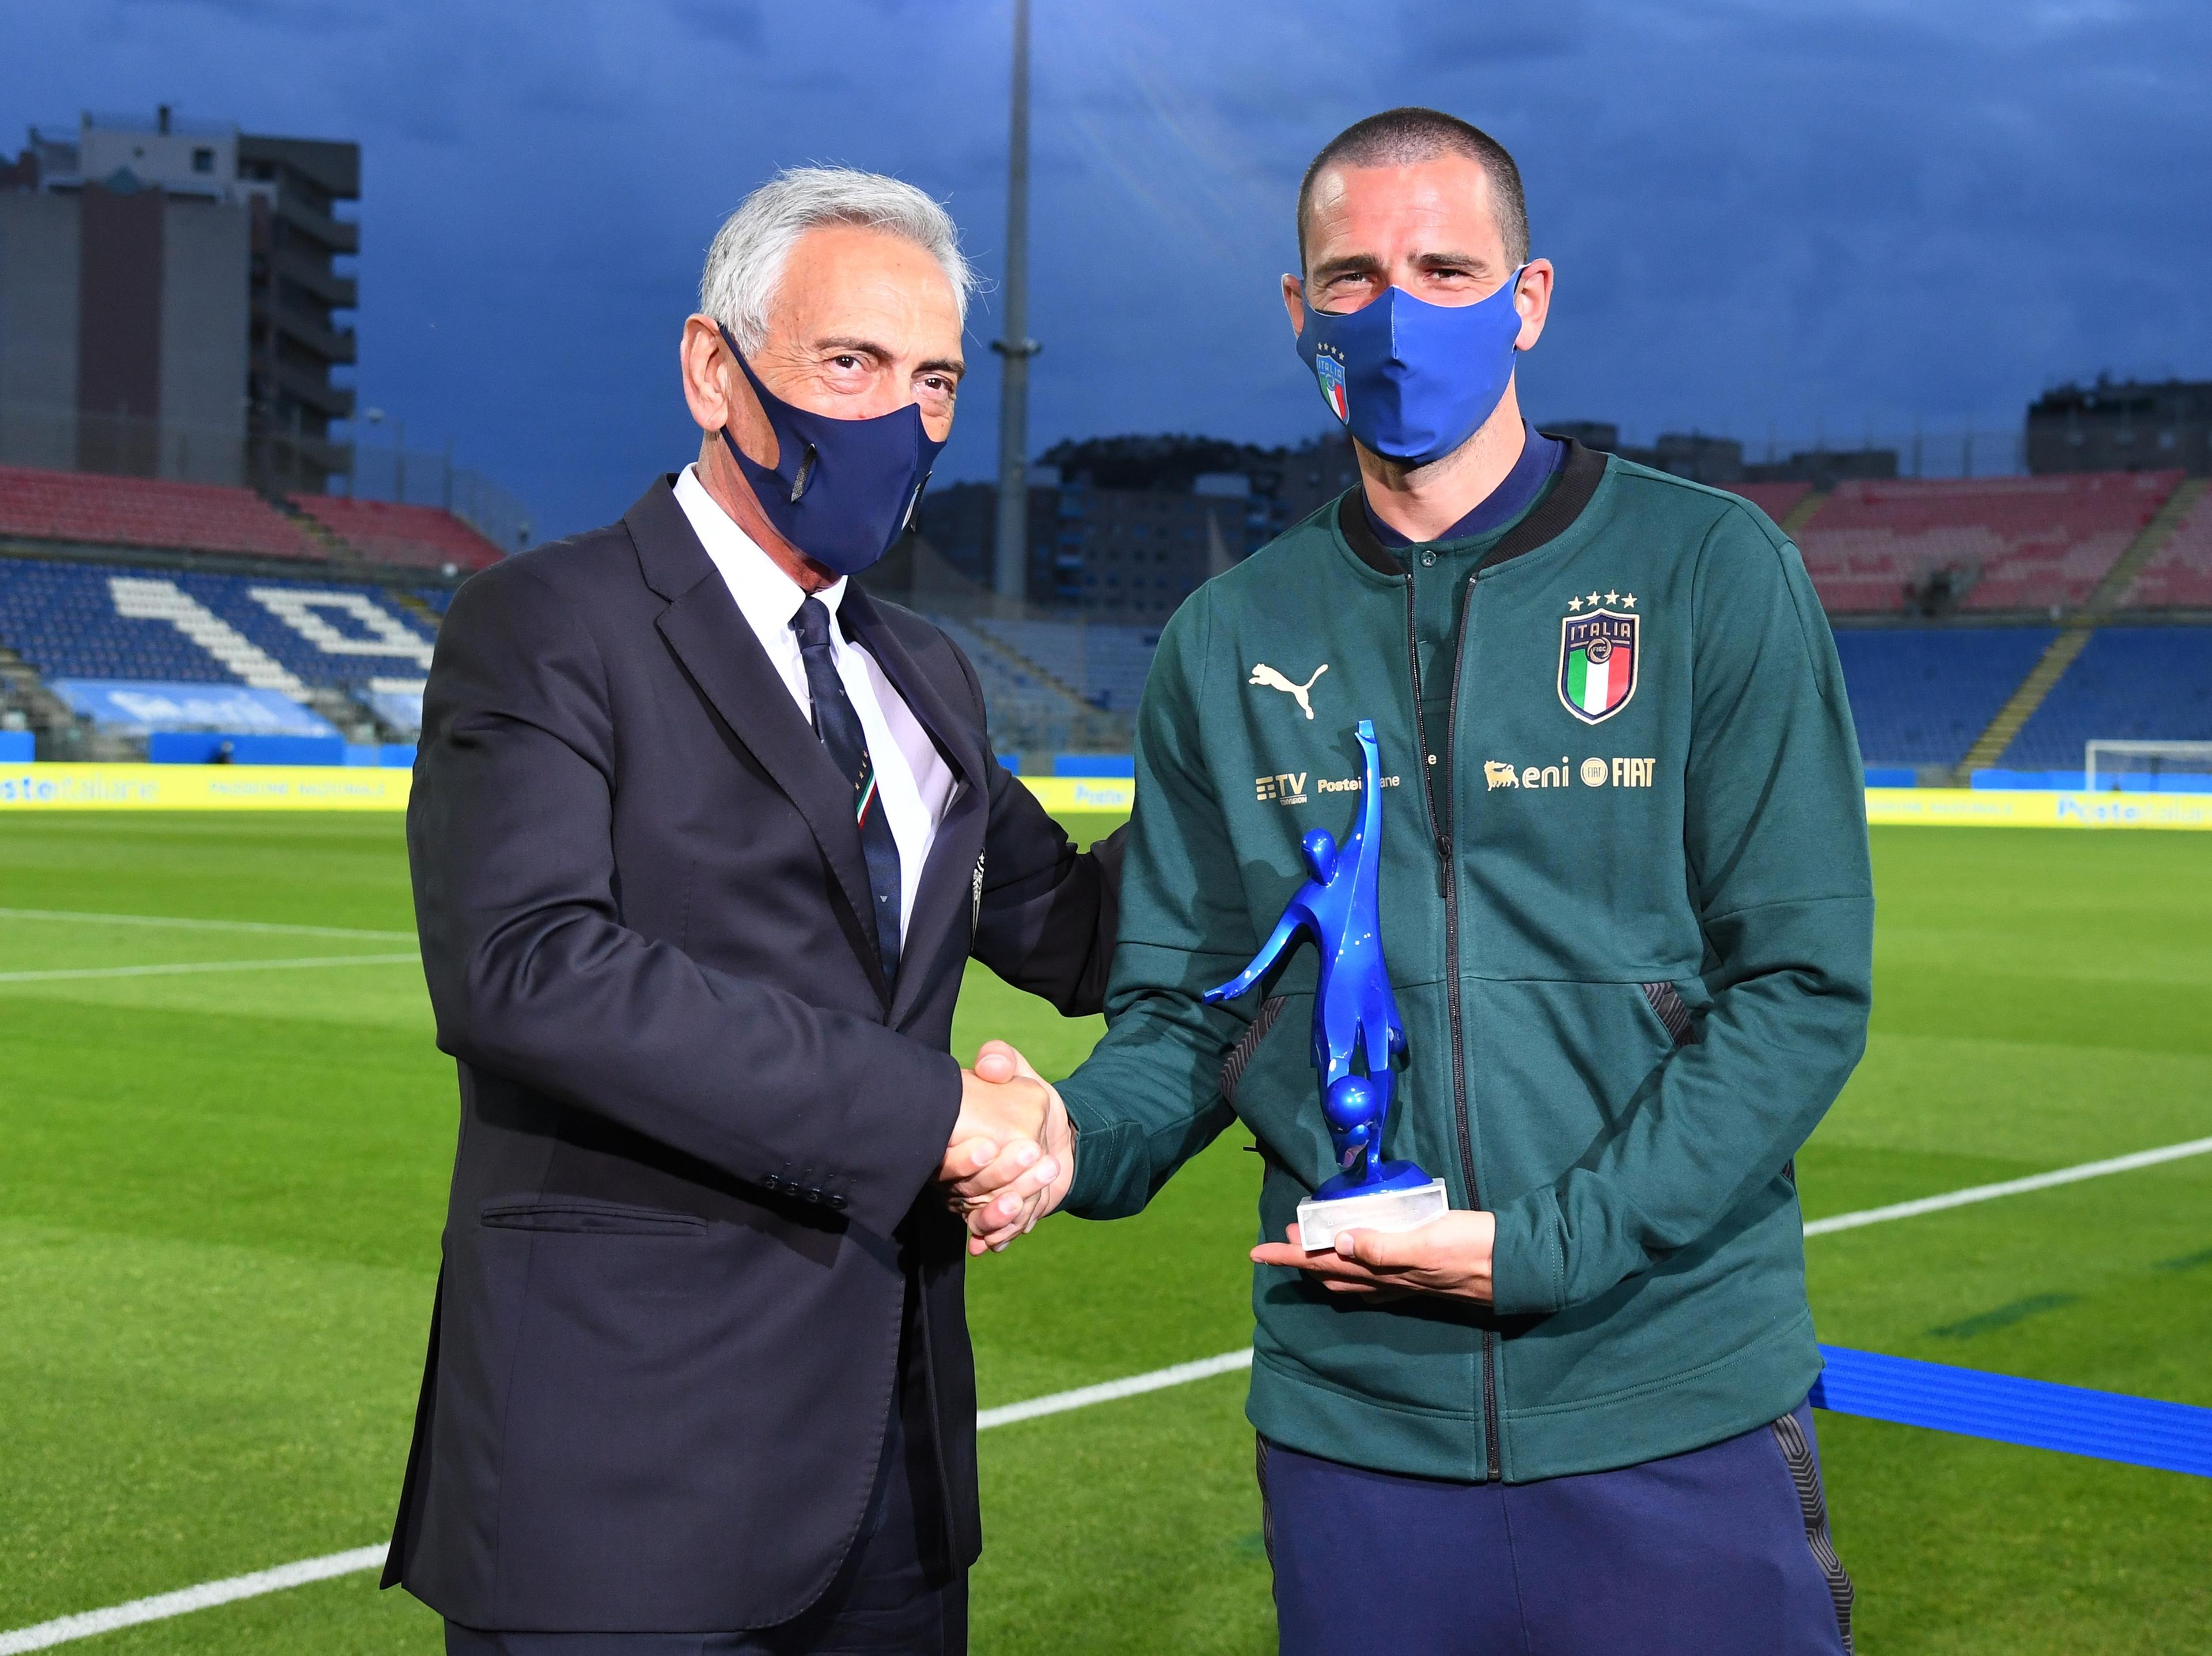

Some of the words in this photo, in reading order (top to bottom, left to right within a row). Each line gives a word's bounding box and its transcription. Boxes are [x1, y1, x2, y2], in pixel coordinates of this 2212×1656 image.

[1318, 359, 1342, 380] ITALIA
[1570, 622, 1631, 641] ITALIA
[1522, 756, 1569, 789] eni
[1587, 766, 1602, 778] FIAT
[1612, 757, 1656, 787] FIAT
